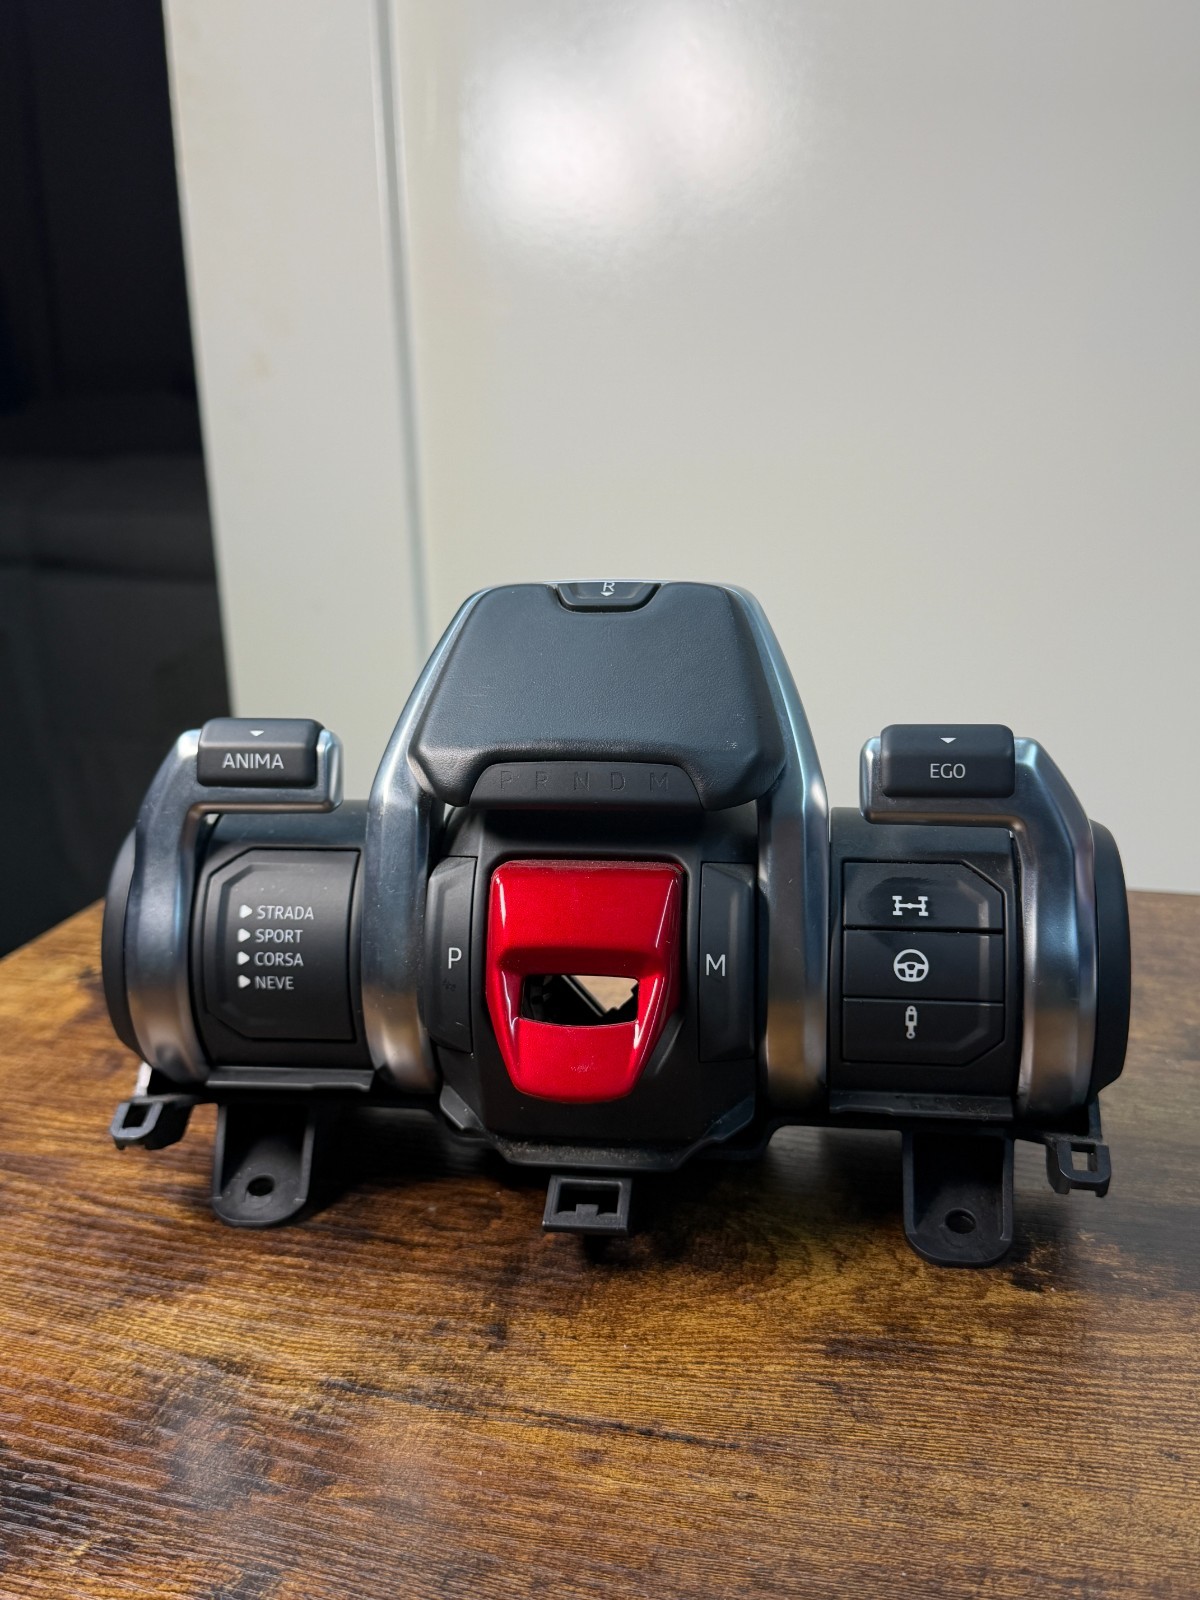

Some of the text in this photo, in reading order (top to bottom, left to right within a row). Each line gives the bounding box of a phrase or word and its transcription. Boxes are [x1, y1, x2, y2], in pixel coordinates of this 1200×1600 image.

[602, 581, 616, 592] R
[221, 752, 285, 770] ANIMA
[929, 763, 966, 779] EGO
[500, 771, 669, 792] P R N D M
[256, 905, 315, 921] STRADA
[254, 928, 304, 944] SPORT
[253, 951, 304, 968] CORSA
[447, 947, 462, 969] P
[705, 953, 726, 977] M
[255, 975, 295, 991] NEVE
